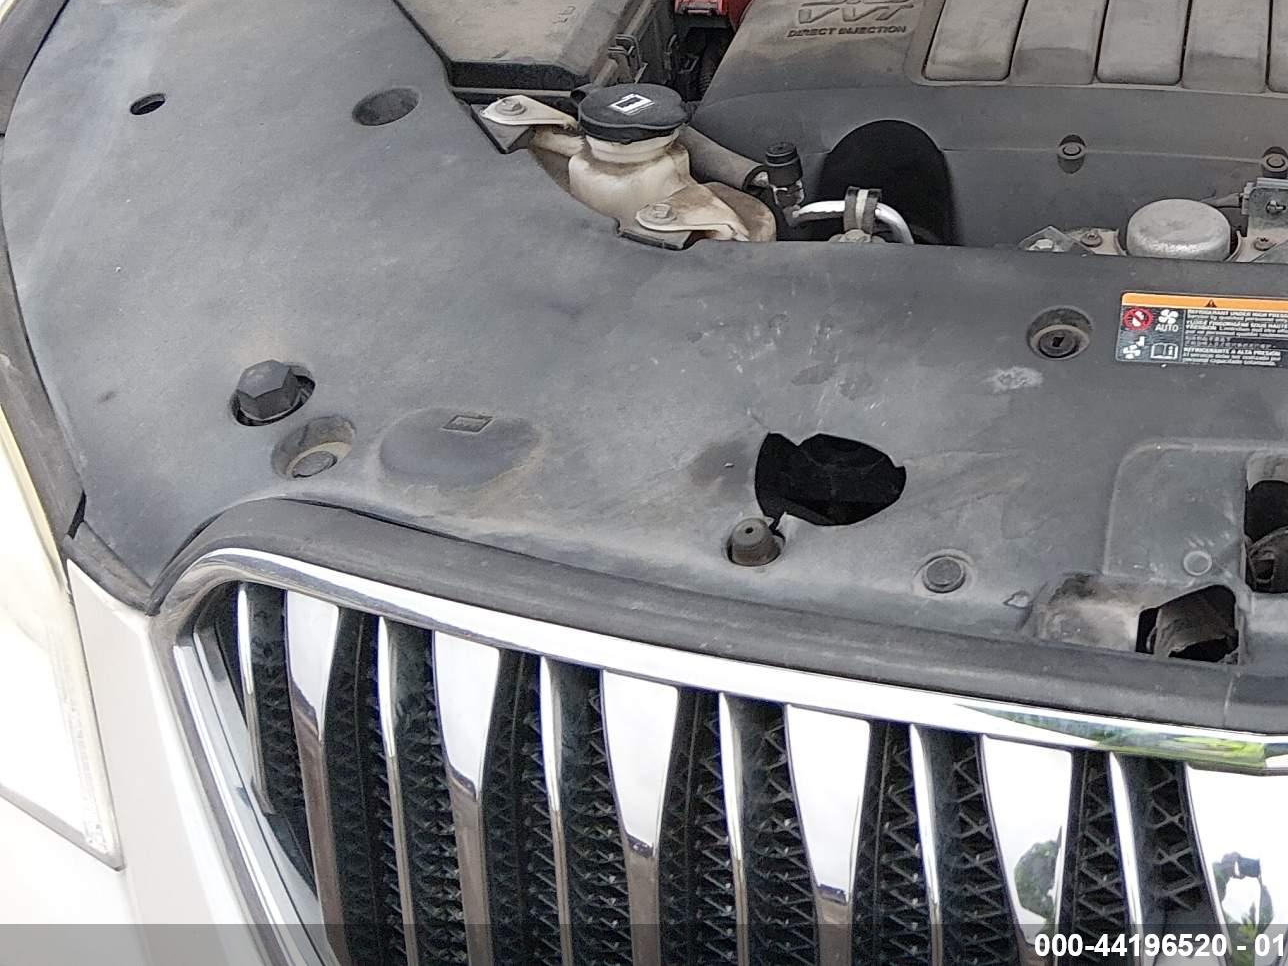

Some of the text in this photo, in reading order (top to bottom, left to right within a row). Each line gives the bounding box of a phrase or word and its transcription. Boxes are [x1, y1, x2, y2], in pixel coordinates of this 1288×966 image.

[787, 25, 906, 38] DIRECT INJECTION
[1155, 323, 1179, 332] AUTO
